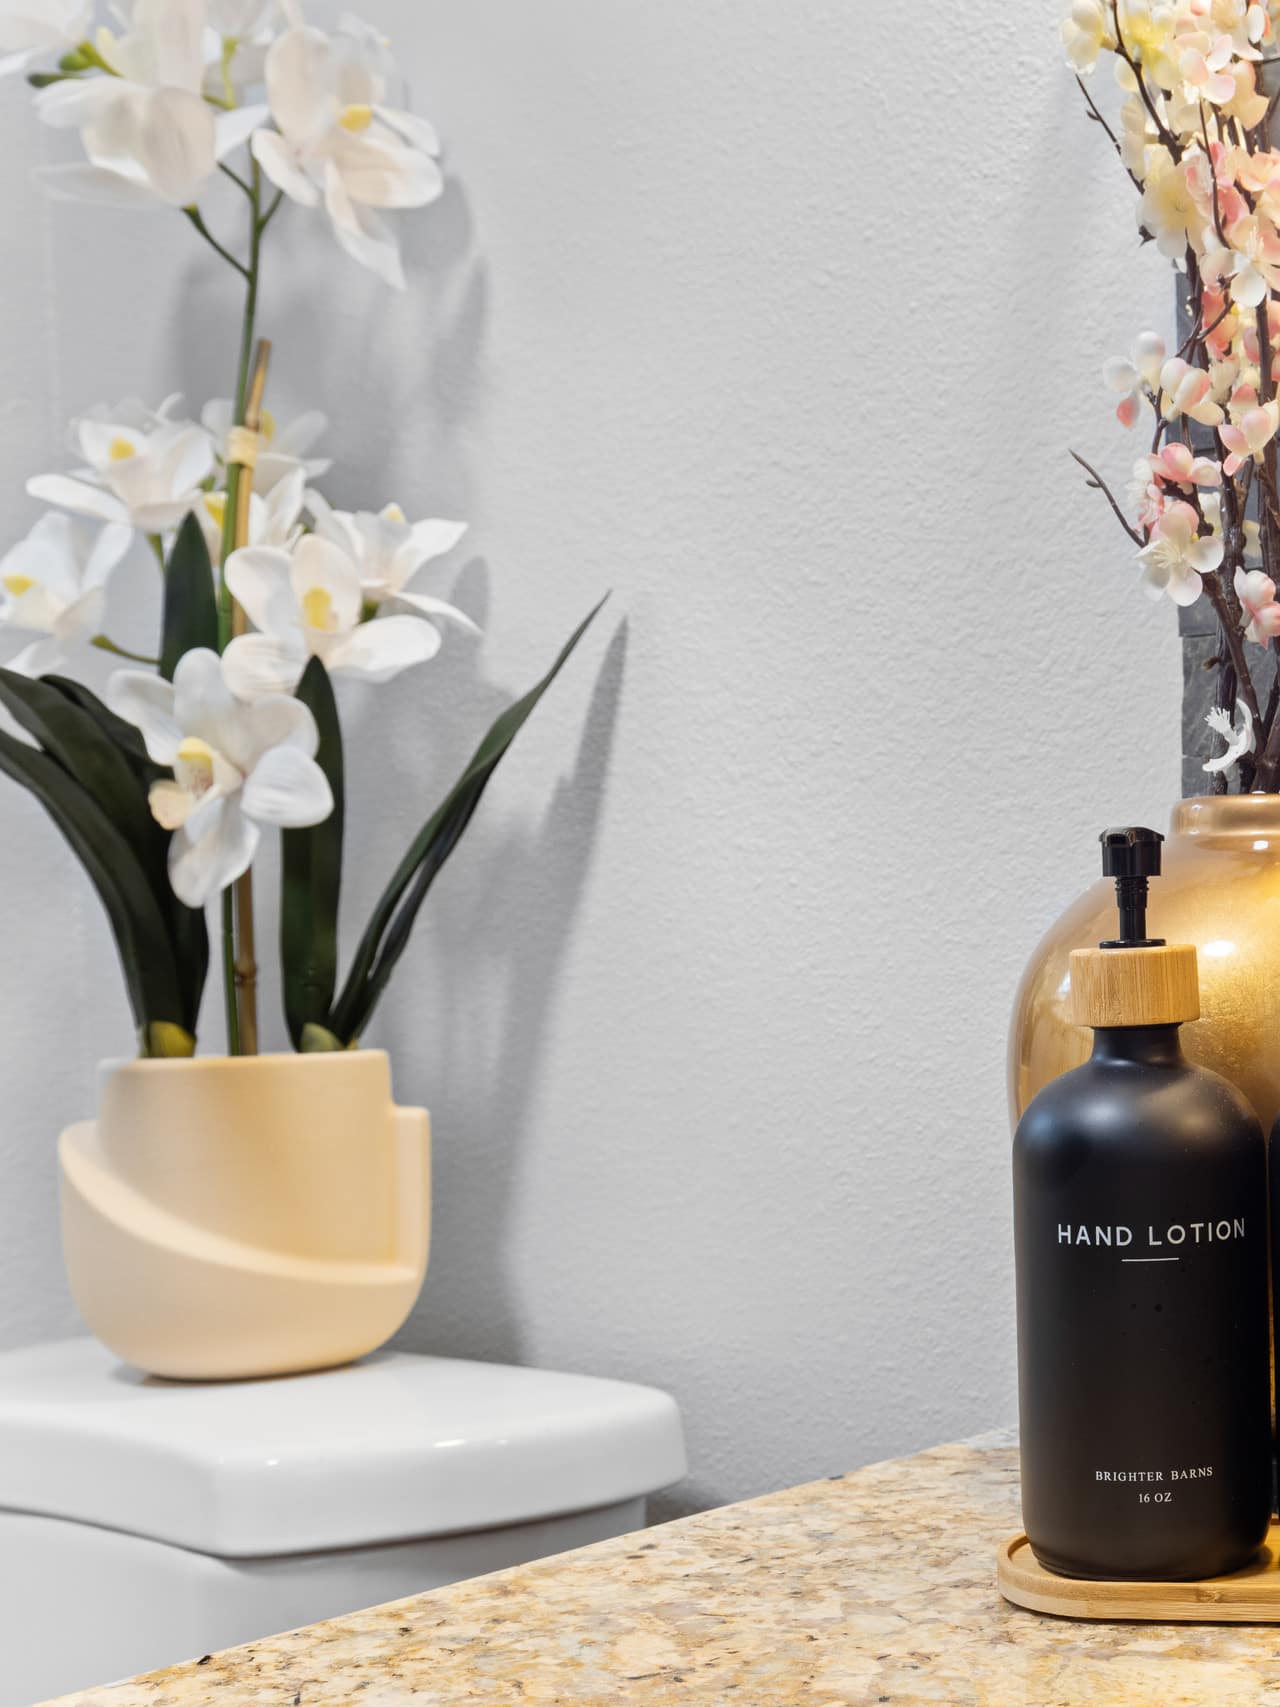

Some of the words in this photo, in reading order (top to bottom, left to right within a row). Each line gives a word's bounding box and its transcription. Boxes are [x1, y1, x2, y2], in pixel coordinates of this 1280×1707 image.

[1057, 1223, 1133, 1247] HAND
[1148, 1217, 1246, 1247] LOTION
[1095, 1470, 1164, 1483] BRIGHTER
[1170, 1466, 1214, 1481] BARNS
[1138, 1493, 1151, 1504] 16
[1154, 1492, 1173, 1503] OZ
